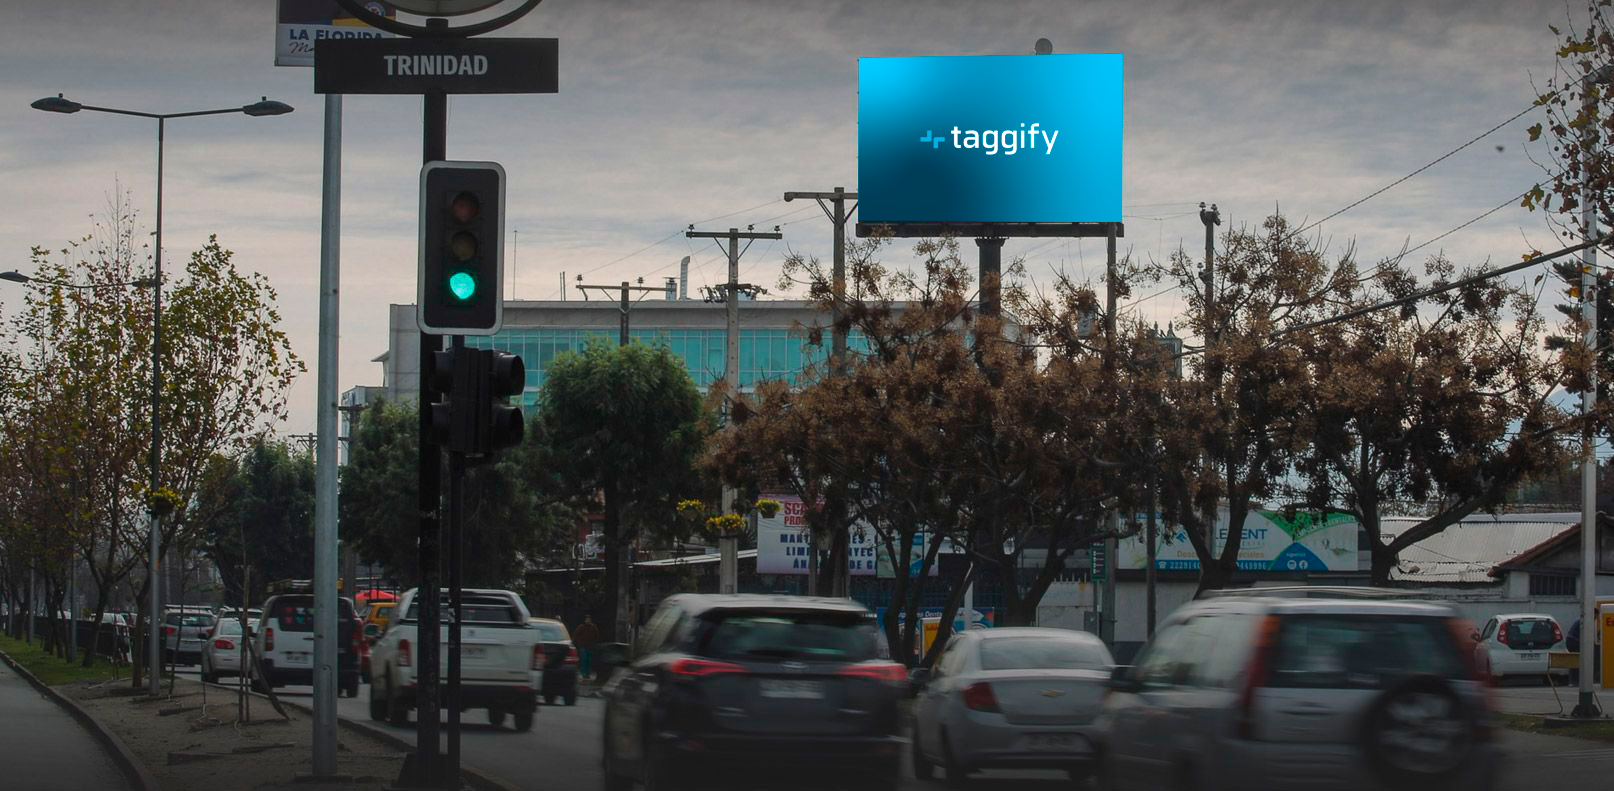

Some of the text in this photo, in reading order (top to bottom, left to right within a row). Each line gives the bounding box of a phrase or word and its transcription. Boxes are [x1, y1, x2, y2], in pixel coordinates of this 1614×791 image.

[289, 29, 309, 40] LA
[384, 55, 488, 76] TRINIDAD
[950, 122, 1059, 155] taggify
